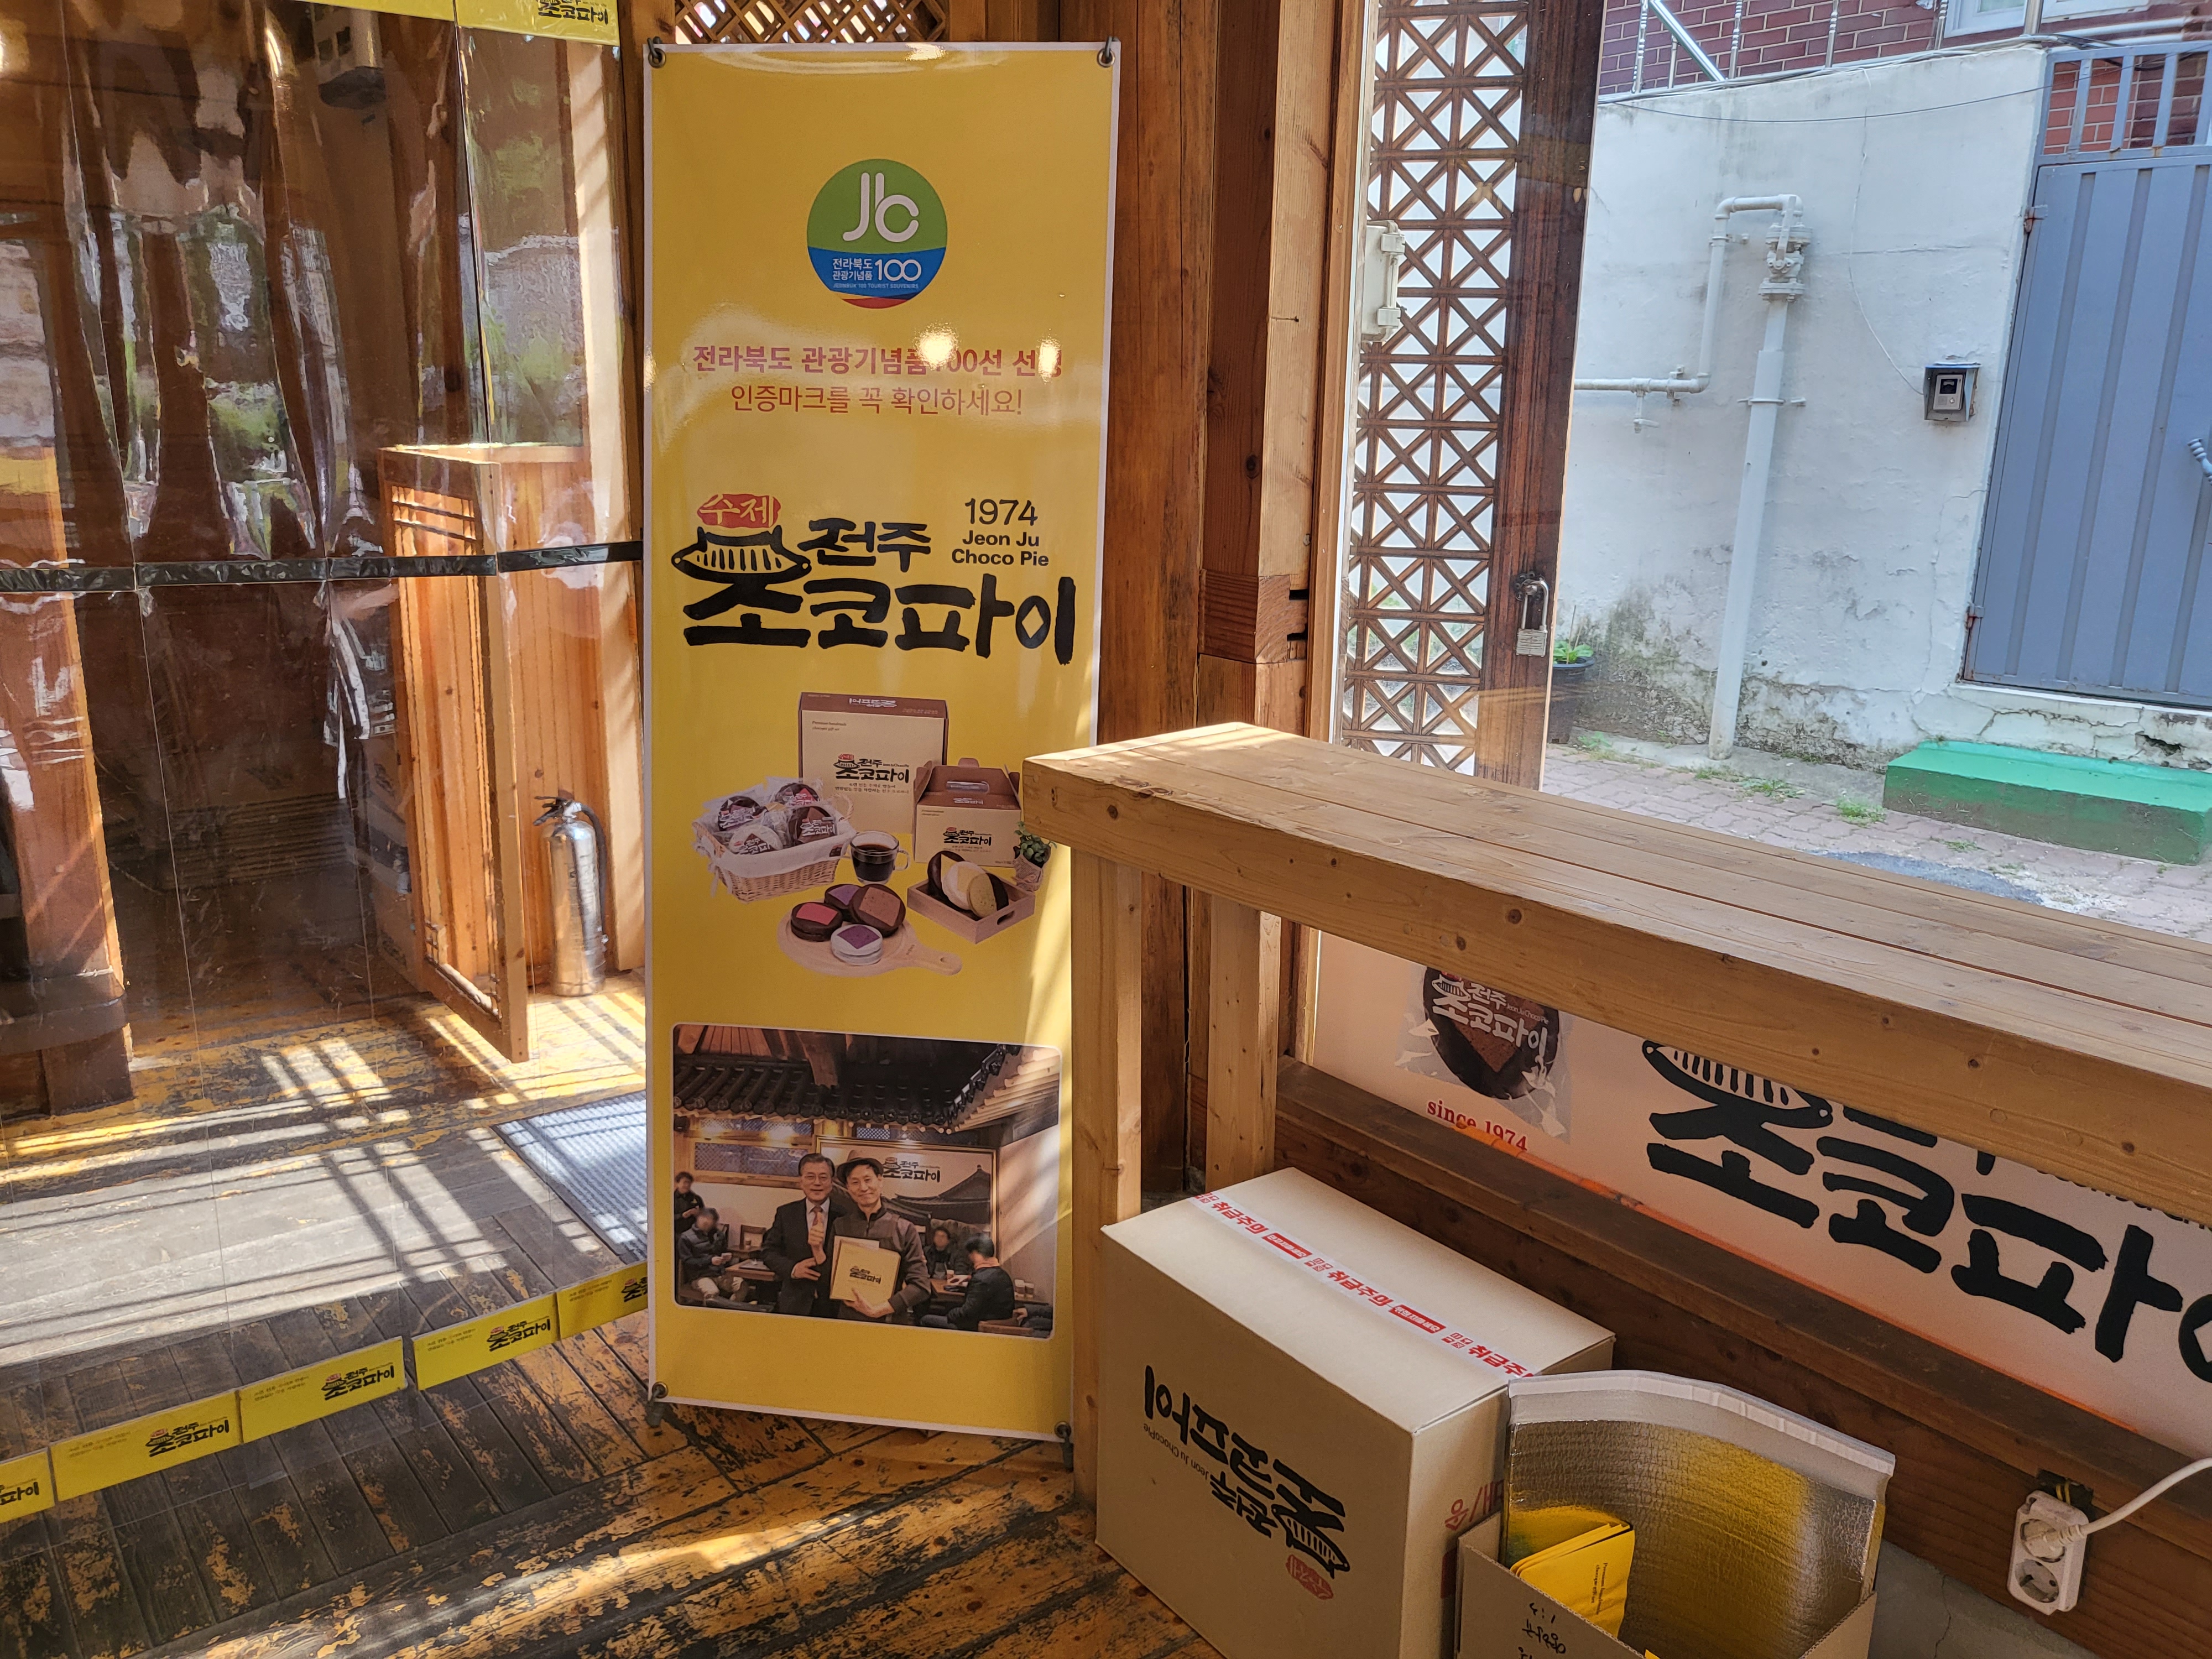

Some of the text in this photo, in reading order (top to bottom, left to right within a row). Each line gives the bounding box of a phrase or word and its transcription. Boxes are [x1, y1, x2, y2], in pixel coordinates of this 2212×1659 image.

[832, 258, 873, 269] 전라북도
[832, 270, 873, 281] 관광기념품
[875, 259, 922, 281] 100
[693, 345, 792, 373] 전라북도
[731, 385, 1022, 416] 인증마크를 꼭 확인하세요!
[698, 494, 775, 528] 수제
[964, 498, 1039, 526] 1974
[797, 517, 931, 572] 전주
[962, 530, 1040, 547] Jeon Ju
[952, 548, 1049, 566] Choco Pie
[674, 547, 1076, 665] 초코파이
[834, 763, 910, 784] 초코파이
[858, 758, 883, 769] 전주
[943, 834, 992, 846] 초코파이
[1468, 982, 1507, 1010] 전주
[1432, 987, 1548, 1056] 초코파이
[1485, 1120, 1528, 1151] 1974
[883, 1165, 941, 1183] 초코파이
[899, 1161, 919, 1169] 전주
[1211, 1201, 1270, 1234] 취급주의
[1327, 1270, 1394, 1307] 취급주의
[488, 1319, 551, 1352] 초코파이
[322, 1365, 395, 1401] 초코파이
[147, 1420, 229, 1457] 초코파이
[1144, 1365, 1350, 1566] 초코파이
[1181, 1452, 1190, 1465] Ju
[1191, 1459, 1210, 1480] Jeon
[1209, 1470, 1279, 1539] 전주
